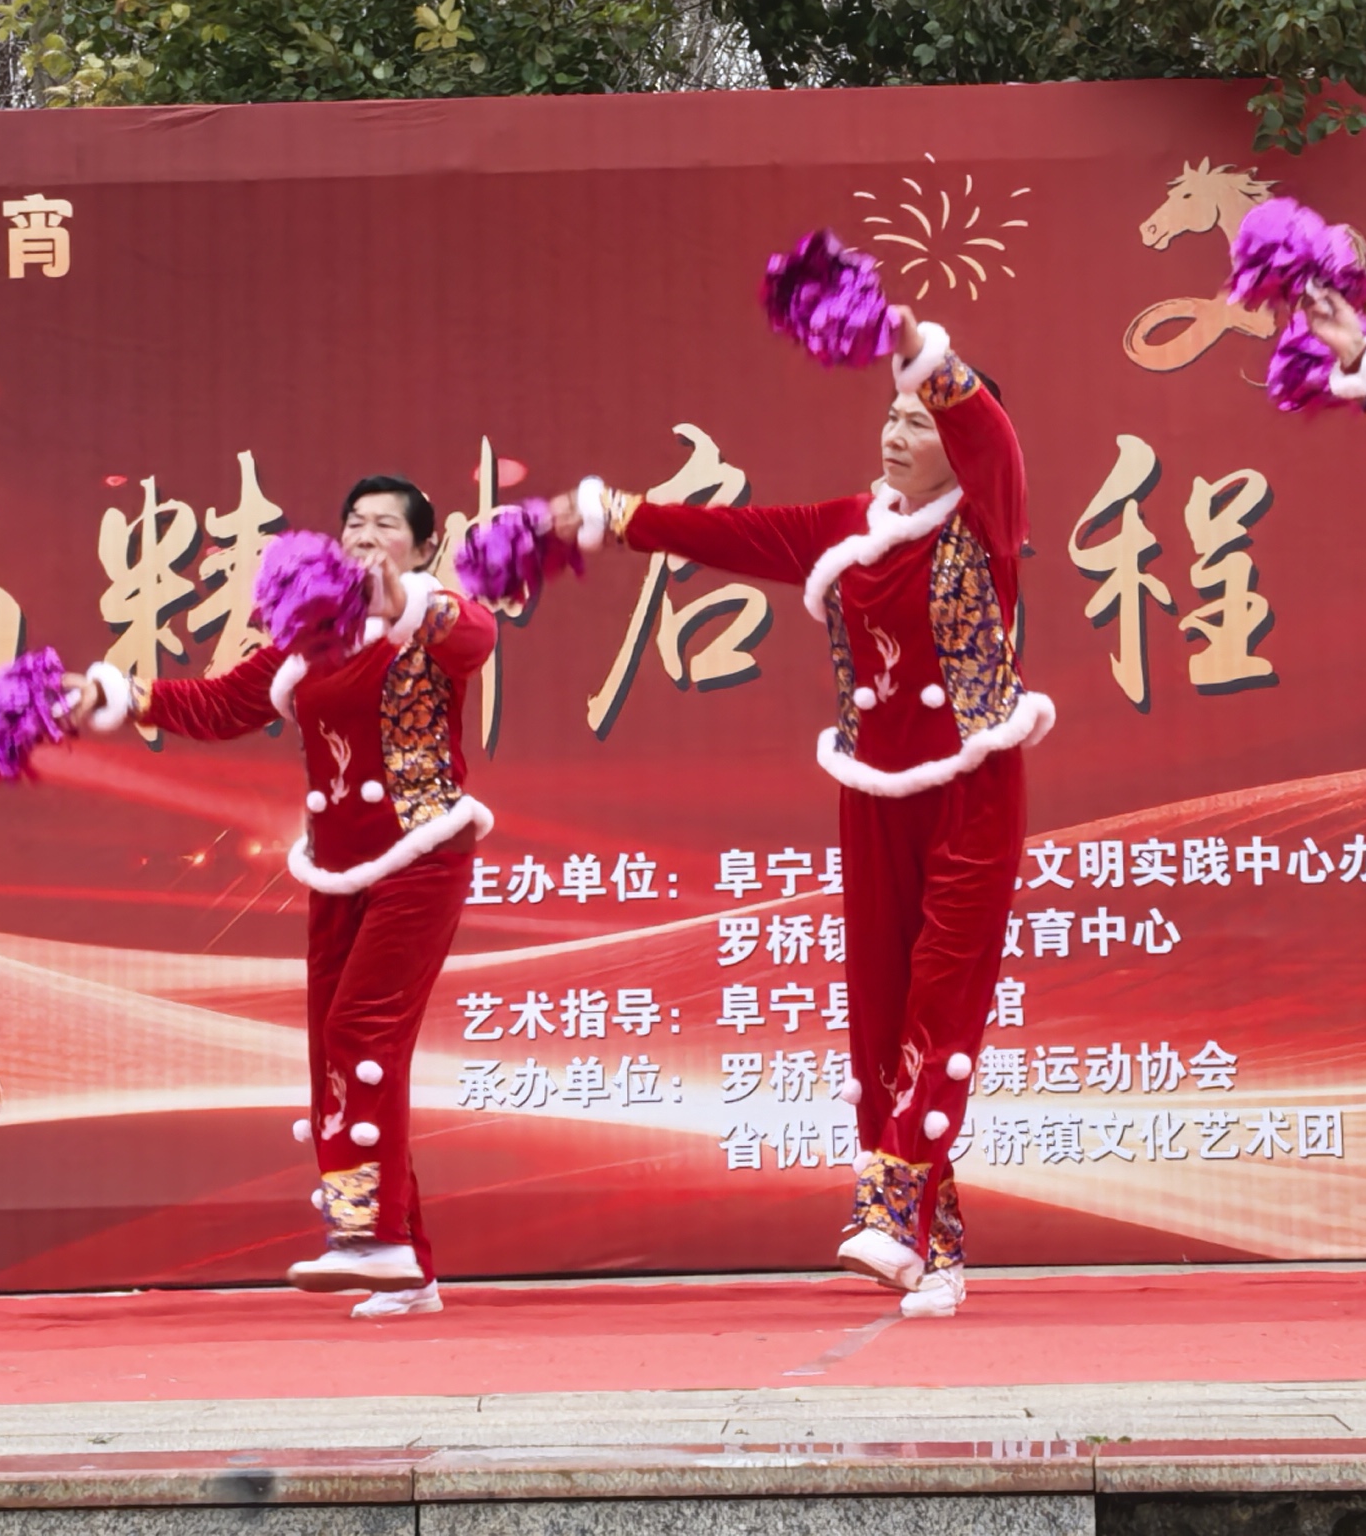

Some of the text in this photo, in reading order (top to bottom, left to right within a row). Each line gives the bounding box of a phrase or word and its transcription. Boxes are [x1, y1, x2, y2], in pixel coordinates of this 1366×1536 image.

[466, 852, 678, 904] 主办单位：
[456, 977, 1026, 1041] 艺术指导： 阜宁县馆
[457, 1055, 683, 1110] 承办单位：
